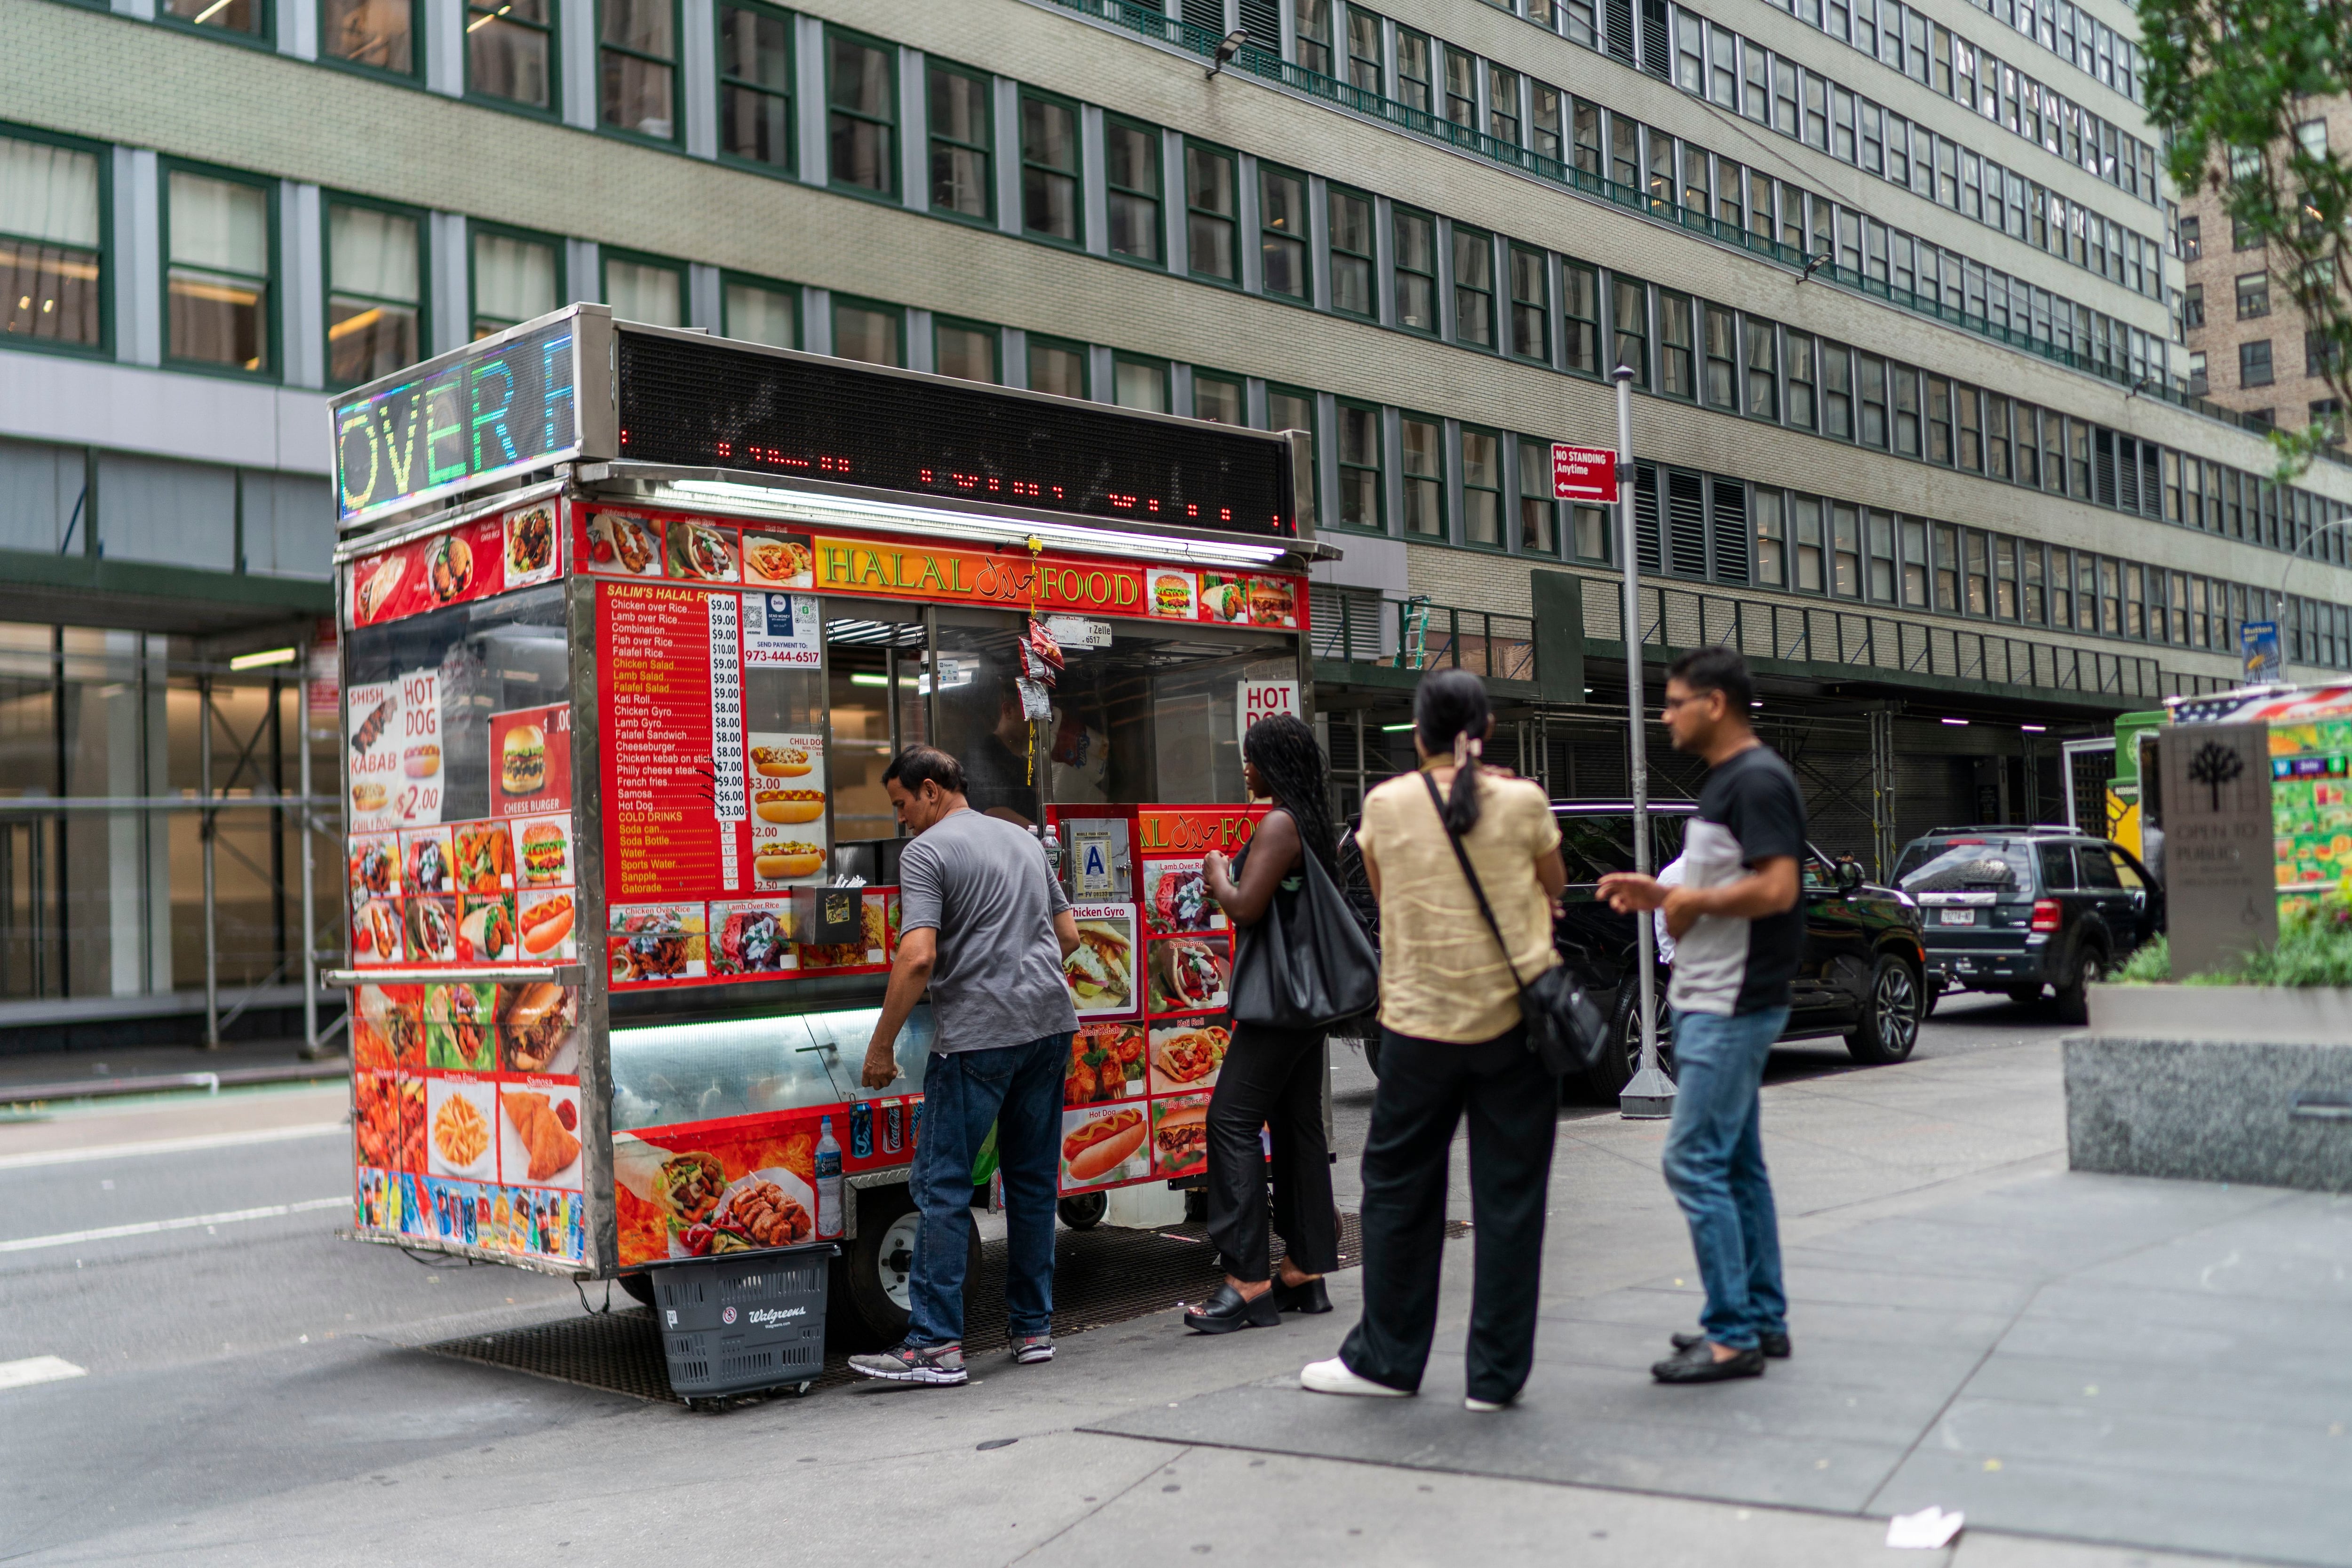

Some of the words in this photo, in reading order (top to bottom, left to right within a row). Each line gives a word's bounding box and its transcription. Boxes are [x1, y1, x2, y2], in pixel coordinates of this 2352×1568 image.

[339, 359, 517, 510] OVER
[1556, 450, 1567, 461] NO
[1569, 451, 1606, 464] STANDING
[1557, 463, 1588, 475] Anytime
[701, 518, 716, 527] Gyro
[824, 546, 972, 593] HALAL
[1038, 566, 1138, 605] FOOD
[607, 584, 653, 598] SALIM'S
[656, 590, 694, 602] HALAL
[611, 599, 645, 611] Chicken
[668, 603, 687, 613] Rice
[711, 599, 735, 611] $9.00
[612, 611, 635, 621] Lamb
[638, 614, 656, 623] over
[659, 615, 677, 624] Rice
[712, 615, 736, 625] $9.00
[612, 623, 665, 635] Combination
[1094, 625, 1111, 635] Zelle
[612, 635, 630, 645] Fish
[654, 637, 673, 646] Rice
[712, 630, 736, 640] $9.00
[612, 647, 642, 657] Falafel
[644, 648, 663, 658] Rice
[713, 645, 736, 655] $10.00
[746, 651, 819, 662] 973-444-6517
[613, 658, 647, 669] Chicken
[650, 660, 674, 669] Salad
[714, 659, 738, 669] $9.00
[613, 670, 637, 680] Lamb
[640, 671, 664, 681] Salad
[714, 673, 738, 684] $9.00
[404, 677, 435, 706] HOT
[614, 682, 643, 692] Falafel
[645, 683, 669, 692] Salad
[350, 687, 383, 707] SHISH
[715, 688, 739, 698] $9.00
[1248, 688, 1290, 708] HOT
[614, 694, 631, 704] Kati
[634, 695, 650, 704] Roll
[614, 706, 649, 716] Chicken
[652, 707, 672, 718] Gyro
[715, 703, 739, 713] $8.00
[406, 708, 436, 737] DOG
[615, 718, 638, 728] Lamb
[641, 718, 662, 730] Gyro
[715, 718, 740, 727] $8.00
[616, 730, 644, 740] Falafel
[647, 730, 687, 740] Sandwich
[716, 732, 740, 742] $8.00
[616, 741, 675, 753] Cheeseburger
[717, 747, 741, 757] $8.00
[616, 753, 650, 764] Chicken
[653, 754, 678, 764] kebab
[693, 754, 713, 764] stick
[350, 754, 397, 776] KABAB
[617, 765, 640, 776] Philly
[643, 766, 673, 775] cheese
[718, 762, 742, 772] $7.00
[618, 777, 647, 787] French
[649, 777, 667, 786] fries
[718, 777, 743, 787] $9.00
[749, 778, 780, 789] $3.00
[618, 789, 652, 798] Samosa
[719, 791, 744, 801] $6.00
[504, 800, 528, 815] CHEESE
[530, 798, 559, 812] BURGER
[618, 801, 633, 810] Hot
[636, 801, 653, 812] Dog
[720, 806, 744, 816] $3.00
[619, 812, 644, 822] COLD
[648, 812, 683, 821] DRINKS
[620, 825, 642, 834] Soda
[620, 836, 642, 846] Soda
[644, 836, 669, 845] Bottle
[620, 849, 646, 858] Water
[621, 860, 648, 871] Sports
[651, 860, 676, 868] Water
[1086, 846, 1104, 875] A
[621, 872, 657, 883] Sanpple
[622, 883, 662, 893] Gatorade
[625, 906, 655, 915] Chicken
[1104, 907, 1125, 918] Gyro
[1191, 1018, 1204, 1026] Roll
[1078, 1027, 1097, 1037] Shish
[1099, 1026, 1120, 1035] Kebab
[526, 1075, 554, 1089] Samosa
[1160, 1100, 1178, 1110] Philly
[1179, 1098, 1203, 1106] Cheese
[1089, 1110, 1101, 1119] Hot
[1102, 1109, 1116, 1118] Dog
[821, 1162, 839, 1172] Spring
[748, 1306, 806, 1325] Walgreens
